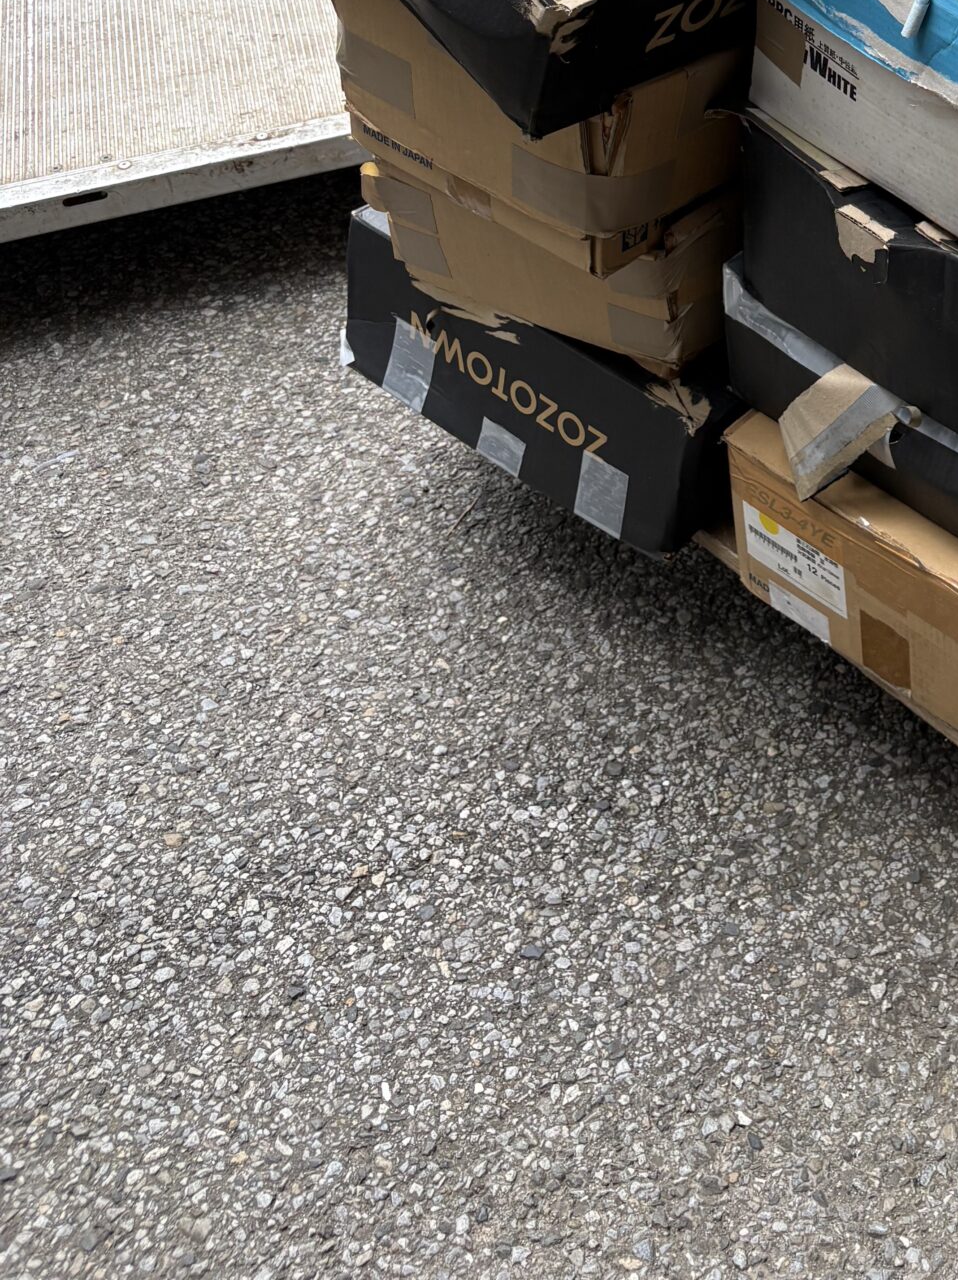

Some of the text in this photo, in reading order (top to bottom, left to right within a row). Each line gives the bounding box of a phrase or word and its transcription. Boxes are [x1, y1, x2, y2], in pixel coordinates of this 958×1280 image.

[363, 124, 434, 171] MADE IN JAPAN
[410, 310, 608, 463] ZOZOTOWN
[749, 572, 770, 593] MAD
[806, 563, 819, 577] 12
